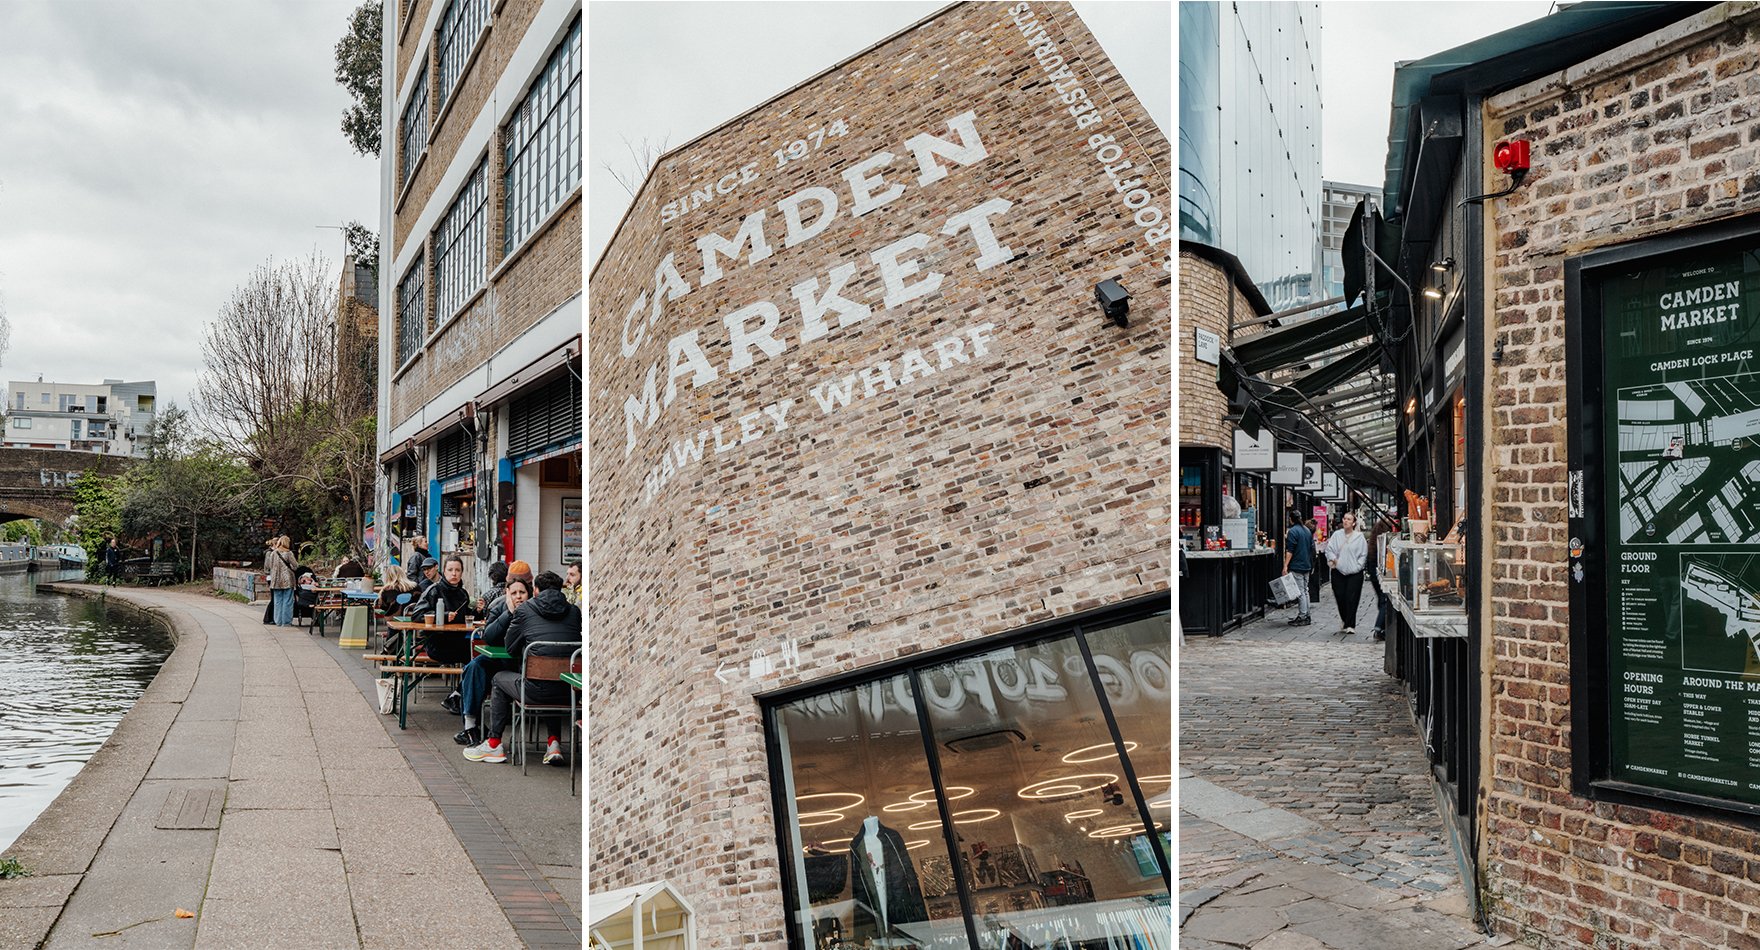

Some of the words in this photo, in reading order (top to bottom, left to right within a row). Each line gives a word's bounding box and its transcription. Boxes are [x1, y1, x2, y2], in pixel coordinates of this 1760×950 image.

[1008, 2, 1103, 130] RESTAURANTS
[661, 161, 760, 225] SINCE
[773, 119, 850, 169] 1974
[1088, 134, 1171, 246] ROOFTOP
[620, 110, 990, 358] CAMDEN
[1682, 269, 1706, 277] WELCOME
[1660, 281, 1740, 310] CAMDEN
[624, 198, 1015, 457] MARKET
[1661, 303, 1740, 331] MARKET
[1651, 359, 1689, 372] CAMDEN
[1692, 355, 1718, 366] LOCK
[1721, 350, 1753, 362] PLACE
[646, 398, 794, 500] HAWLEY
[809, 322, 996, 413] WHARF
[1621, 552, 1657, 560] GROUND
[1621, 564, 1650, 573] FLOOR
[1623, 671, 1663, 683] OPENING
[1624, 684, 1653, 695] HOURS
[1683, 677, 1722, 688] AROUND
[1724, 680, 1744, 690] THE
[1630, 765, 1668, 775] CAMDENMARKET
